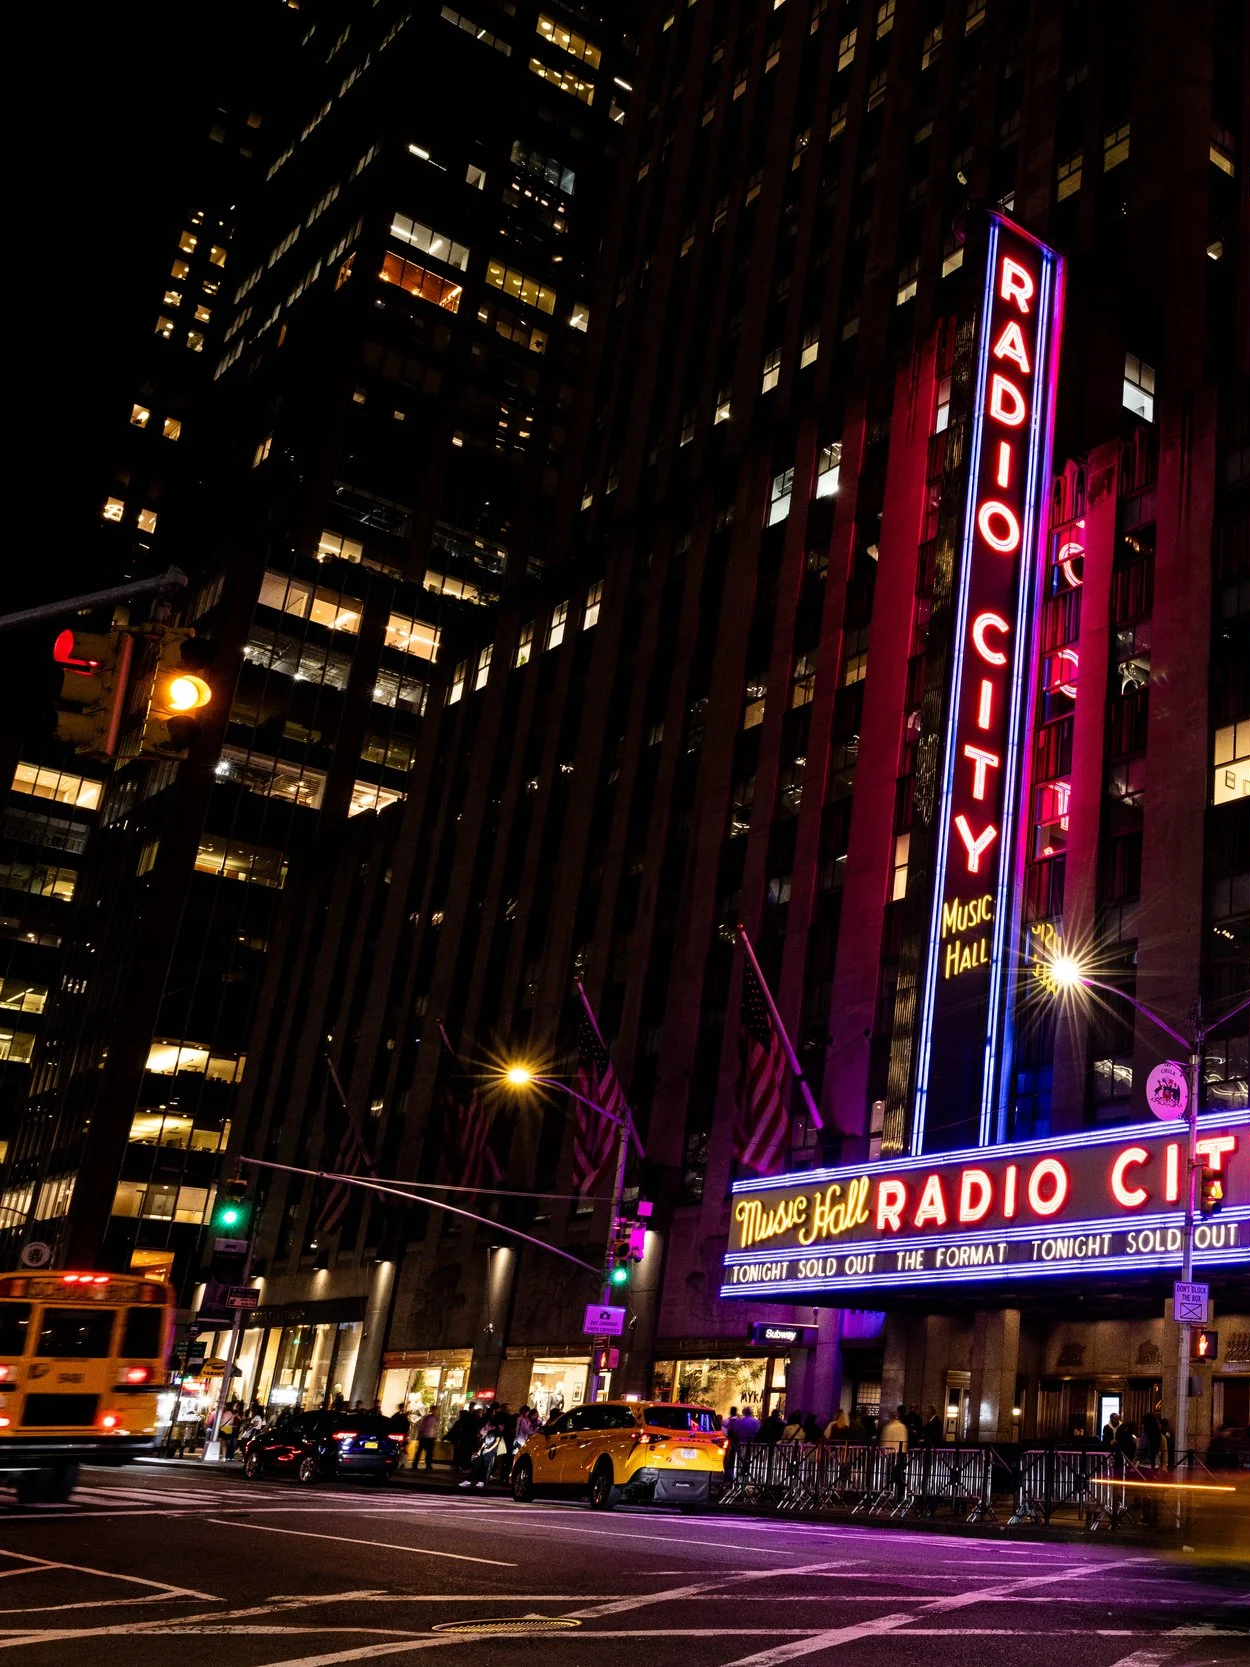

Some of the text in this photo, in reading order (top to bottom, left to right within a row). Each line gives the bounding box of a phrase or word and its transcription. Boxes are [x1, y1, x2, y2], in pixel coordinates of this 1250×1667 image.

[978, 256, 1035, 553] RADIO
[954, 612, 1010, 873] CITY
[735, 1195, 808, 1249] Music
[798, 1175, 870, 1246] Hall
[876, 1157, 1069, 1233] RADIO
[732, 1261, 790, 1284] TONIGHT
[797, 1258, 837, 1279] SOLD
[844, 1254, 876, 1275] OUT
[896, 1249, 924, 1271] THE
[935, 1243, 1007, 1268] FORMAT
[1031, 1233, 1112, 1261] TONIGHT
[1126, 1228, 1181, 1254] SOLD
[1194, 1223, 1239, 1248] OUT
[1182, 1294, 1201, 1303] THE BOX
[1191, 1284, 1207, 1294] BLOCK
[765, 1328, 797, 1341] Subway
